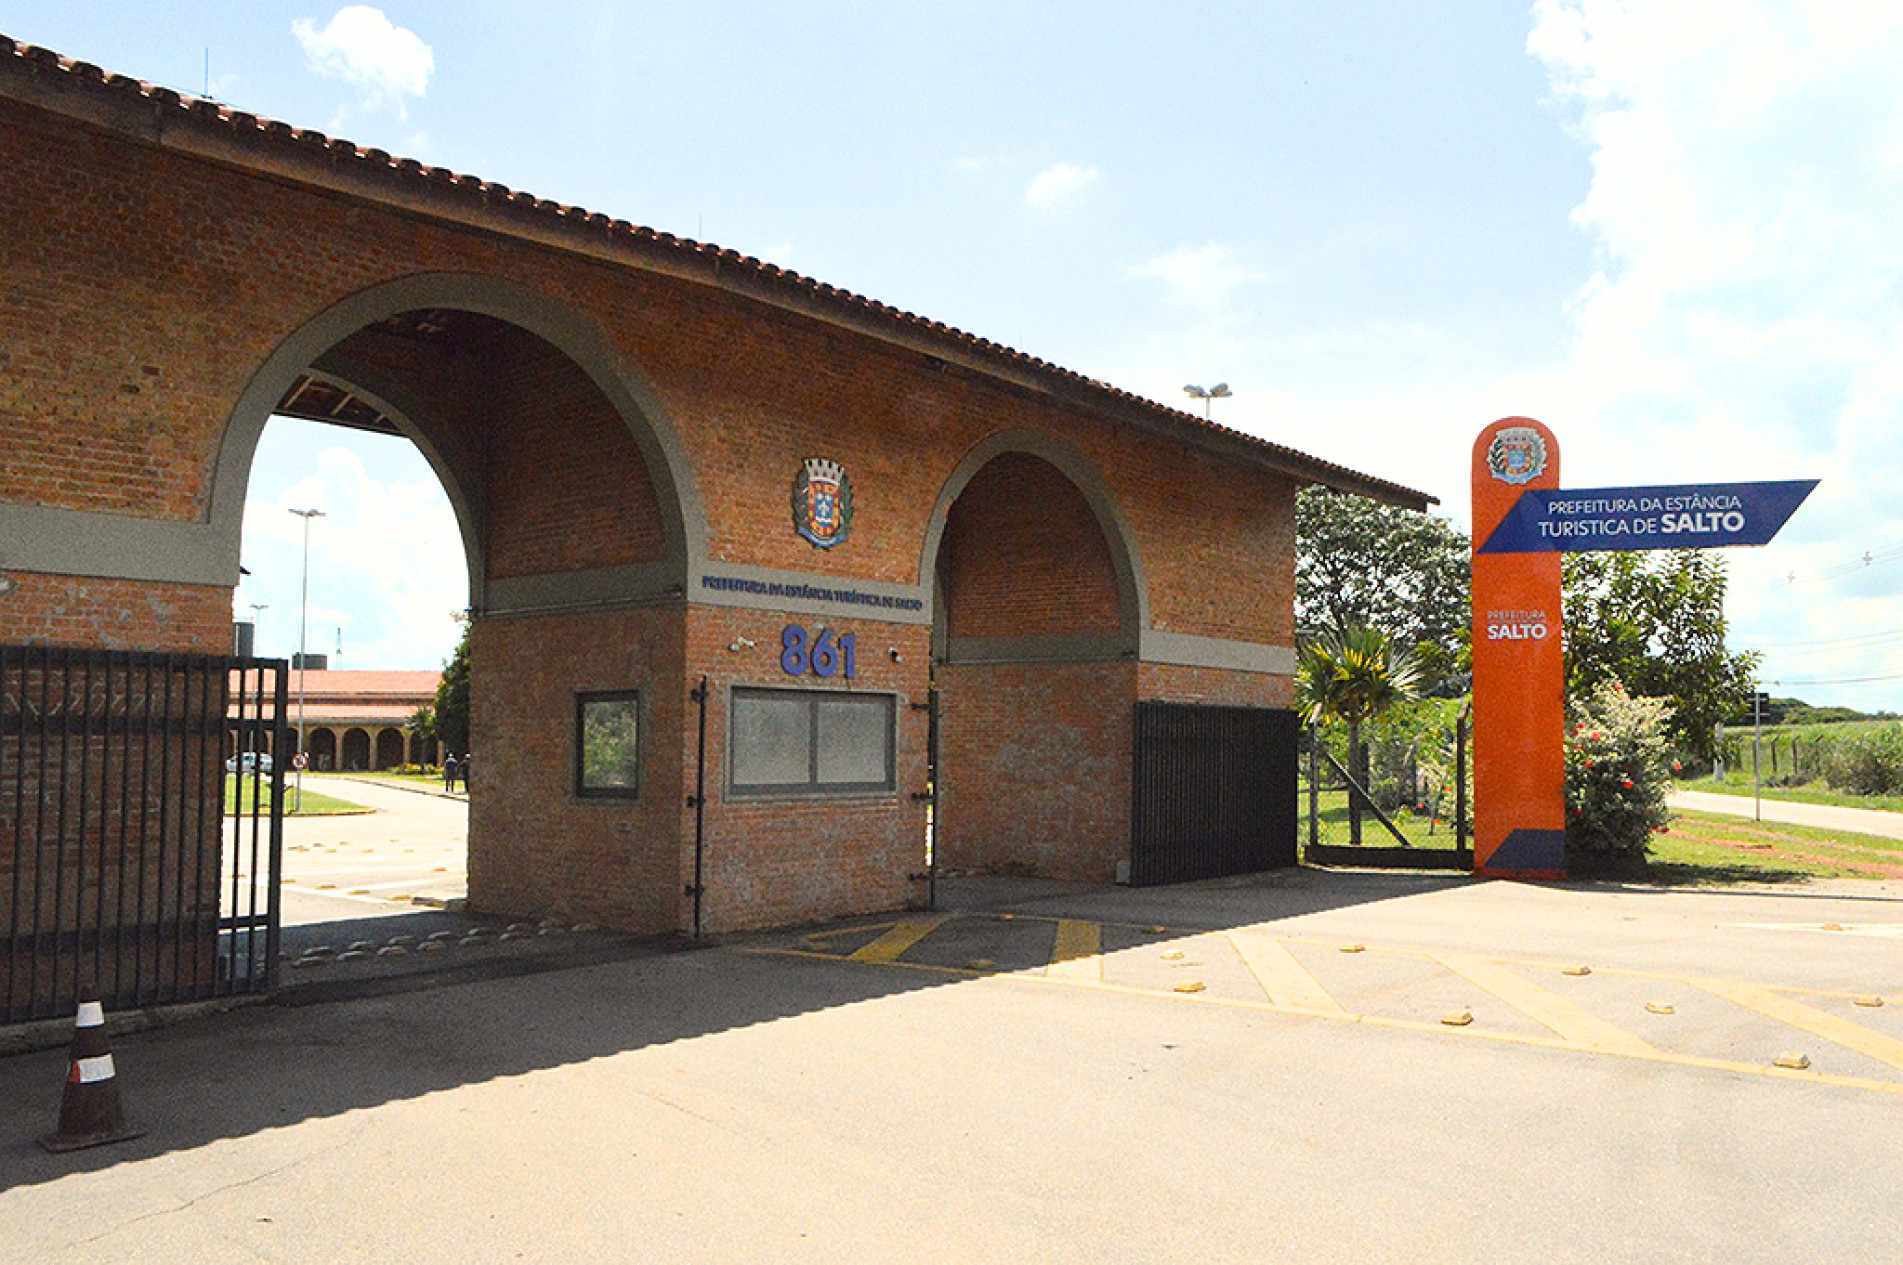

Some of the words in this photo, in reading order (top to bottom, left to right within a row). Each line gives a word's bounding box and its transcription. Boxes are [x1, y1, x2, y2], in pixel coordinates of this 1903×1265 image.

[1548, 499, 1638, 515] PREFEITURA
[1640, 497, 1663, 512] DA
[1665, 493, 1742, 511] ESTÂNCIA
[1633, 517, 1657, 534] DE
[1660, 511, 1745, 534] SALTO
[1487, 623, 1547, 640] SALTO
[781, 623, 856, 679] 861
